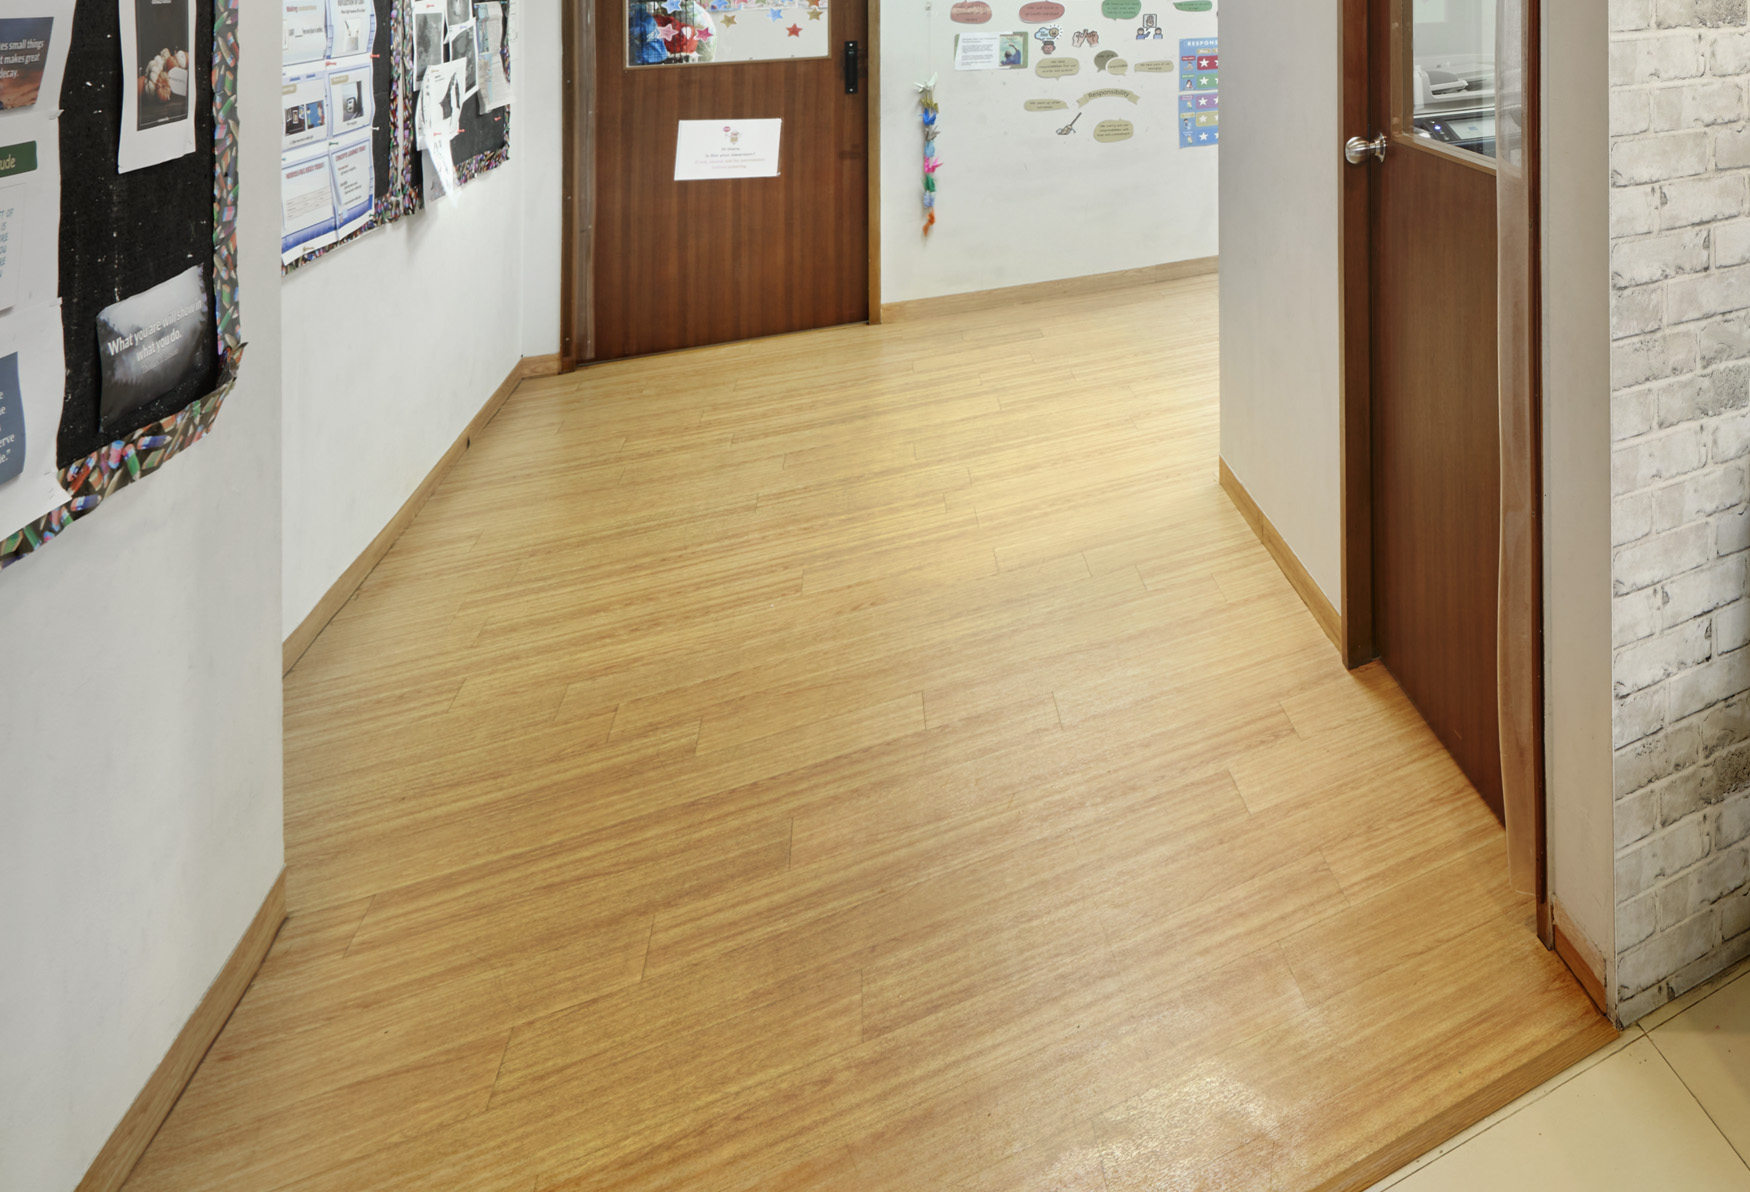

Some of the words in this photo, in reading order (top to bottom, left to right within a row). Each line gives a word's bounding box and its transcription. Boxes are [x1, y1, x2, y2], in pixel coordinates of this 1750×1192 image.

[9, 39, 26, 50] small
[27, 38, 44, 51] things
[4, 53, 24, 64] makes
[25, 52, 40, 64] great
[1088, 89, 1130, 99] Responsibility
[107, 332, 133, 356] What
[134, 328, 149, 346] you
[149, 321, 161, 335] are
[162, 311, 176, 328] will
[176, 303, 195, 321] show
[136, 340, 155, 362] what
[155, 336, 169, 352] you
